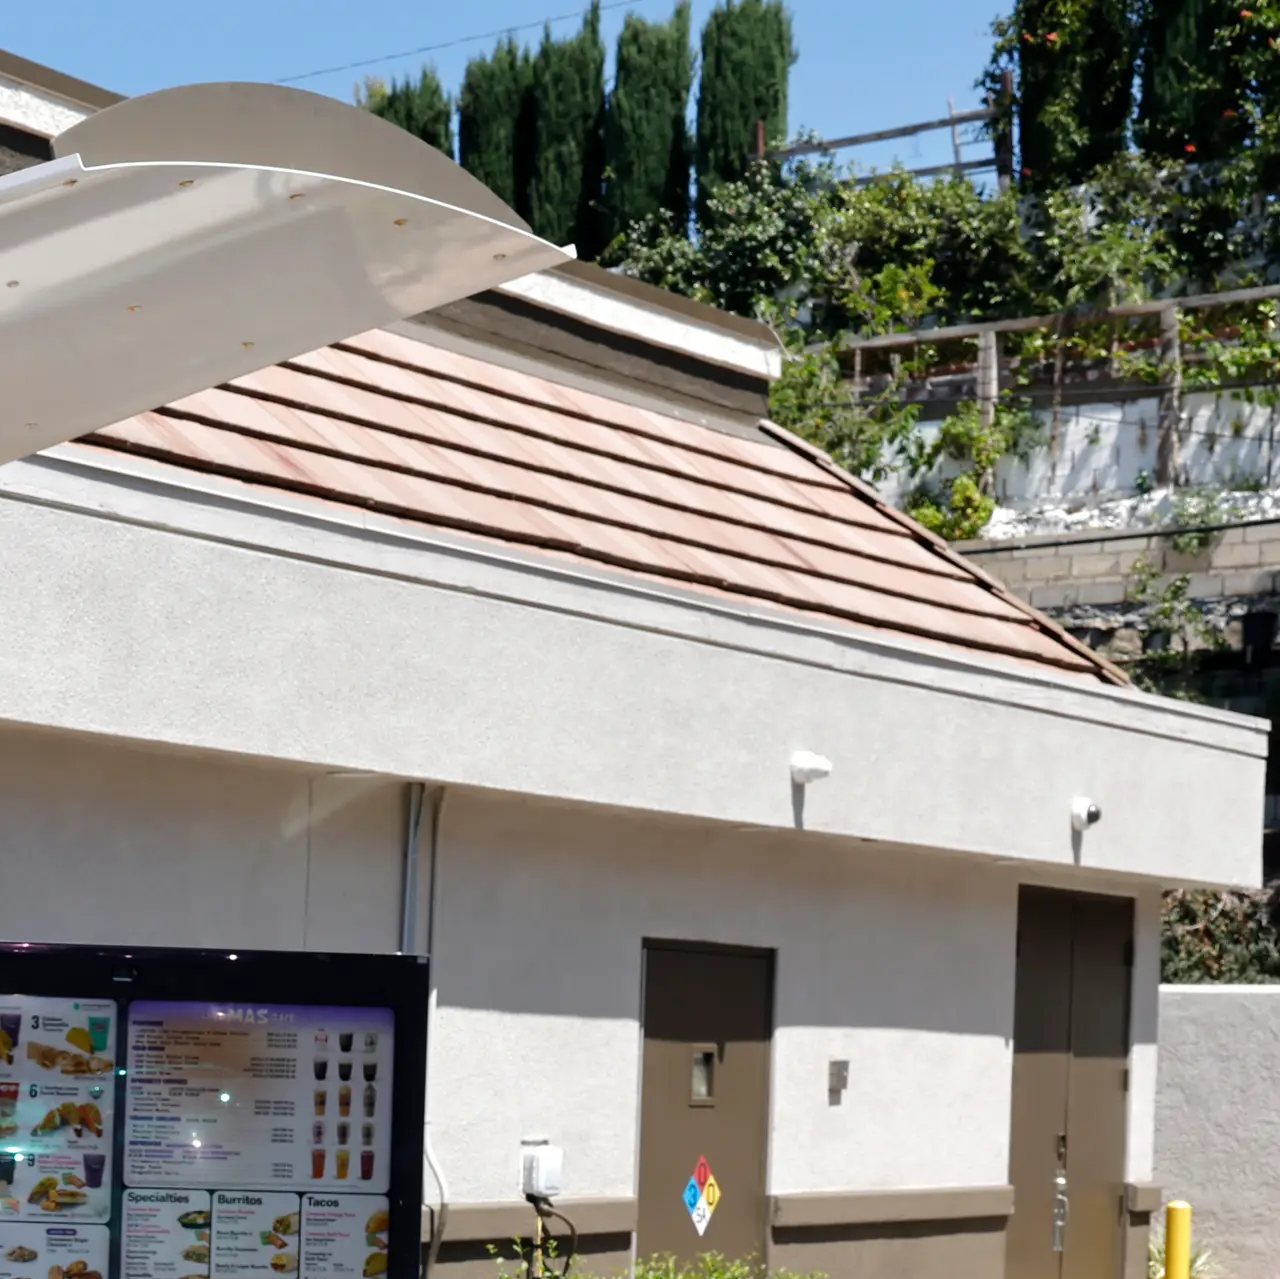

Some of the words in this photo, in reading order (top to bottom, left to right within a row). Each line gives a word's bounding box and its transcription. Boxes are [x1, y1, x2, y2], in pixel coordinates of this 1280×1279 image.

[31, 1015, 40, 1029] 3
[29, 1084, 38, 1098] 6
[27, 1153, 35, 1167] 9
[127, 1192, 190, 1204] Specialties
[217, 1194, 263, 1206] Burritos
[306, 1196, 340, 1208] Tacos
